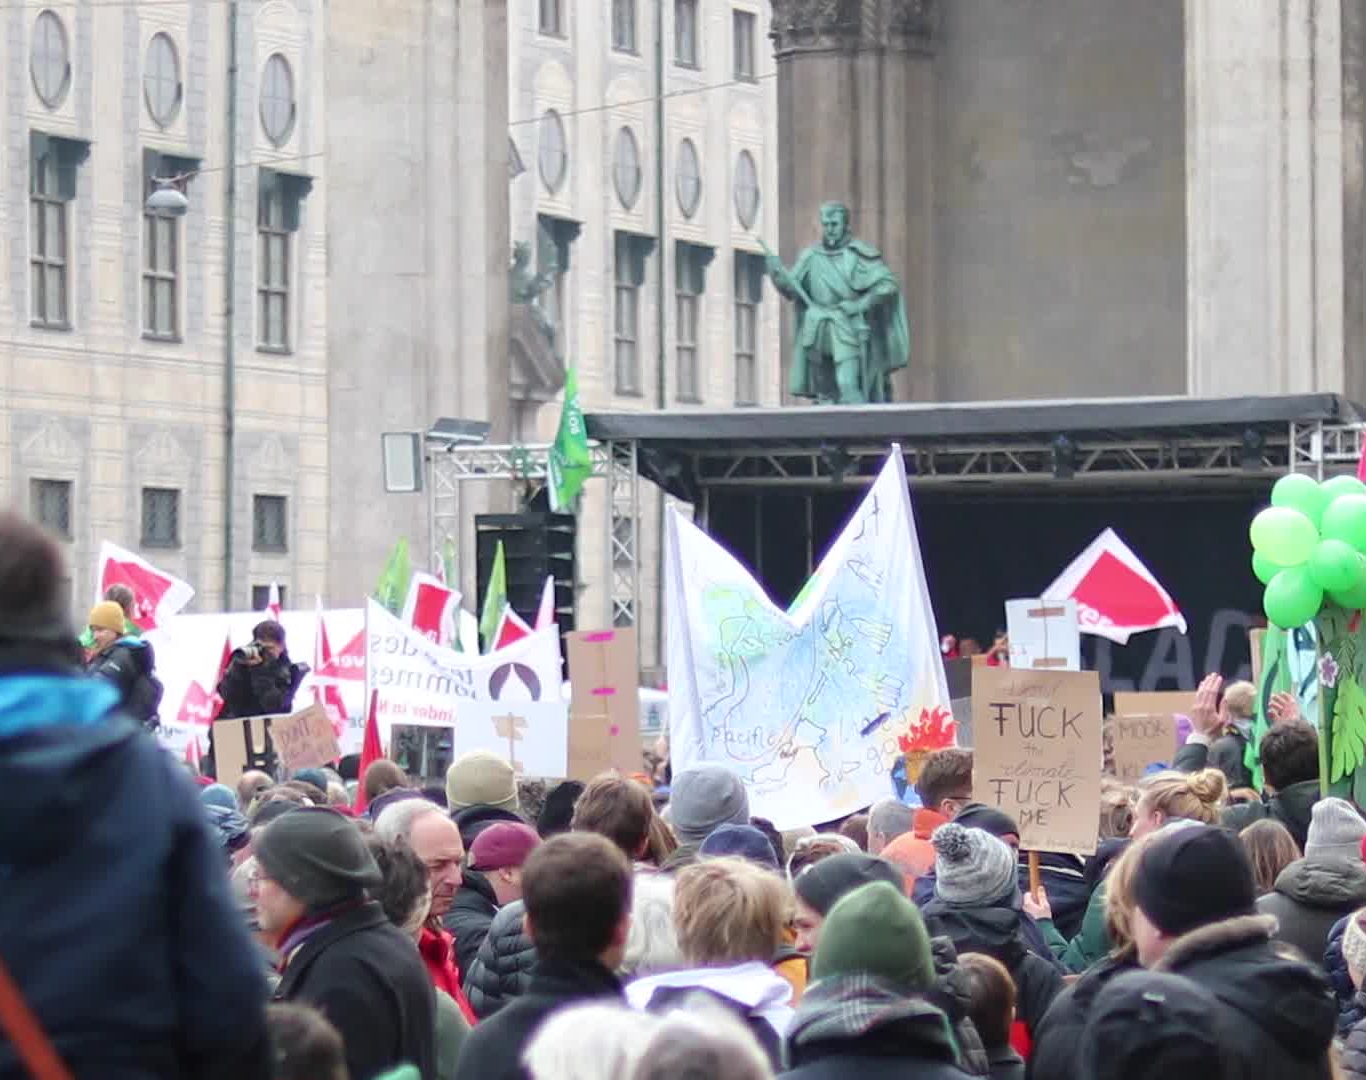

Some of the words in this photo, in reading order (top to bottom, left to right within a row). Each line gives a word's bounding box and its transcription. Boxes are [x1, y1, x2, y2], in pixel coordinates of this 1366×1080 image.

[988, 702, 1084, 739] FUCK
[988, 778, 1076, 809] FUCK
[1019, 808, 1049, 827] ME
